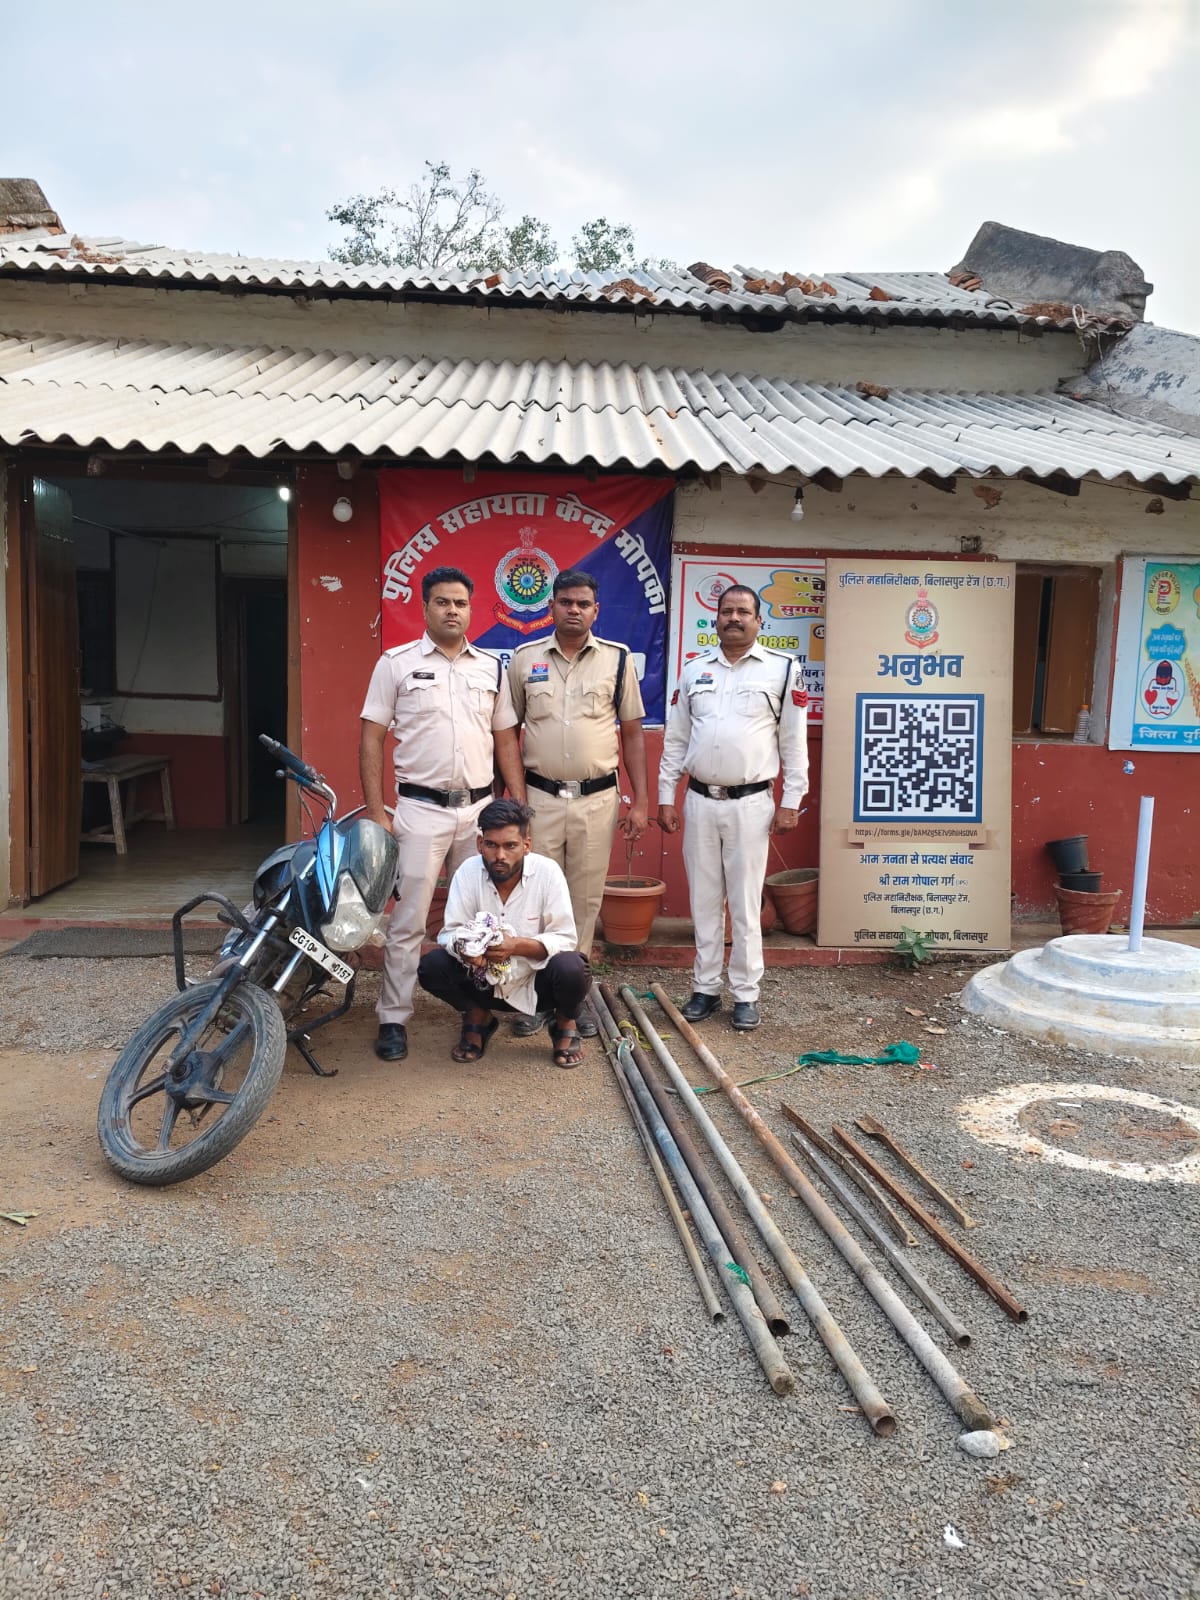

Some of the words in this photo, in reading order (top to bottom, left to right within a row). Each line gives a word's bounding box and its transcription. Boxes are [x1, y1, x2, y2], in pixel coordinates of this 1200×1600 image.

[382, 523, 440, 604] पुलिस
[436, 492, 549, 535] सहायता
[555, 492, 616, 538] केन्द्र
[614, 529, 667, 616] मोपका
[839, 572, 865, 588] पुलिस
[866, 572, 922, 587] महानिरीक्षक,
[924, 573, 964, 589] बिलासपुर
[780, 605, 820, 617] सुगम
[877, 654, 964, 686] अनुभव
[1139, 726, 1178, 739] जिला
[860, 854, 879, 864] आम
[882, 854, 908, 864] जनता
[910, 852, 919, 864] से
[921, 854, 947, 864] प्रत्यक्ष
[949, 852, 974, 864] संवाद
[879, 874, 890, 886] श्री
[892, 876, 909, 886] राम
[911, 874, 939, 886] गोपाल
[941, 874, 955, 886] गर्ग
[863, 892, 882, 903] पुलिस
[926, 893, 957, 904] बिलासपुर
[891, 905, 920, 916] बिलासपुर
[854, 929, 876, 942] पुलिस
[878, 931, 906, 940] सहायता
[953, 929, 989, 943] बिलासपुर
[292, 931, 315, 952] CG10
[320, 952, 329, 963] Y
[333, 963, 351, 980] 0157
